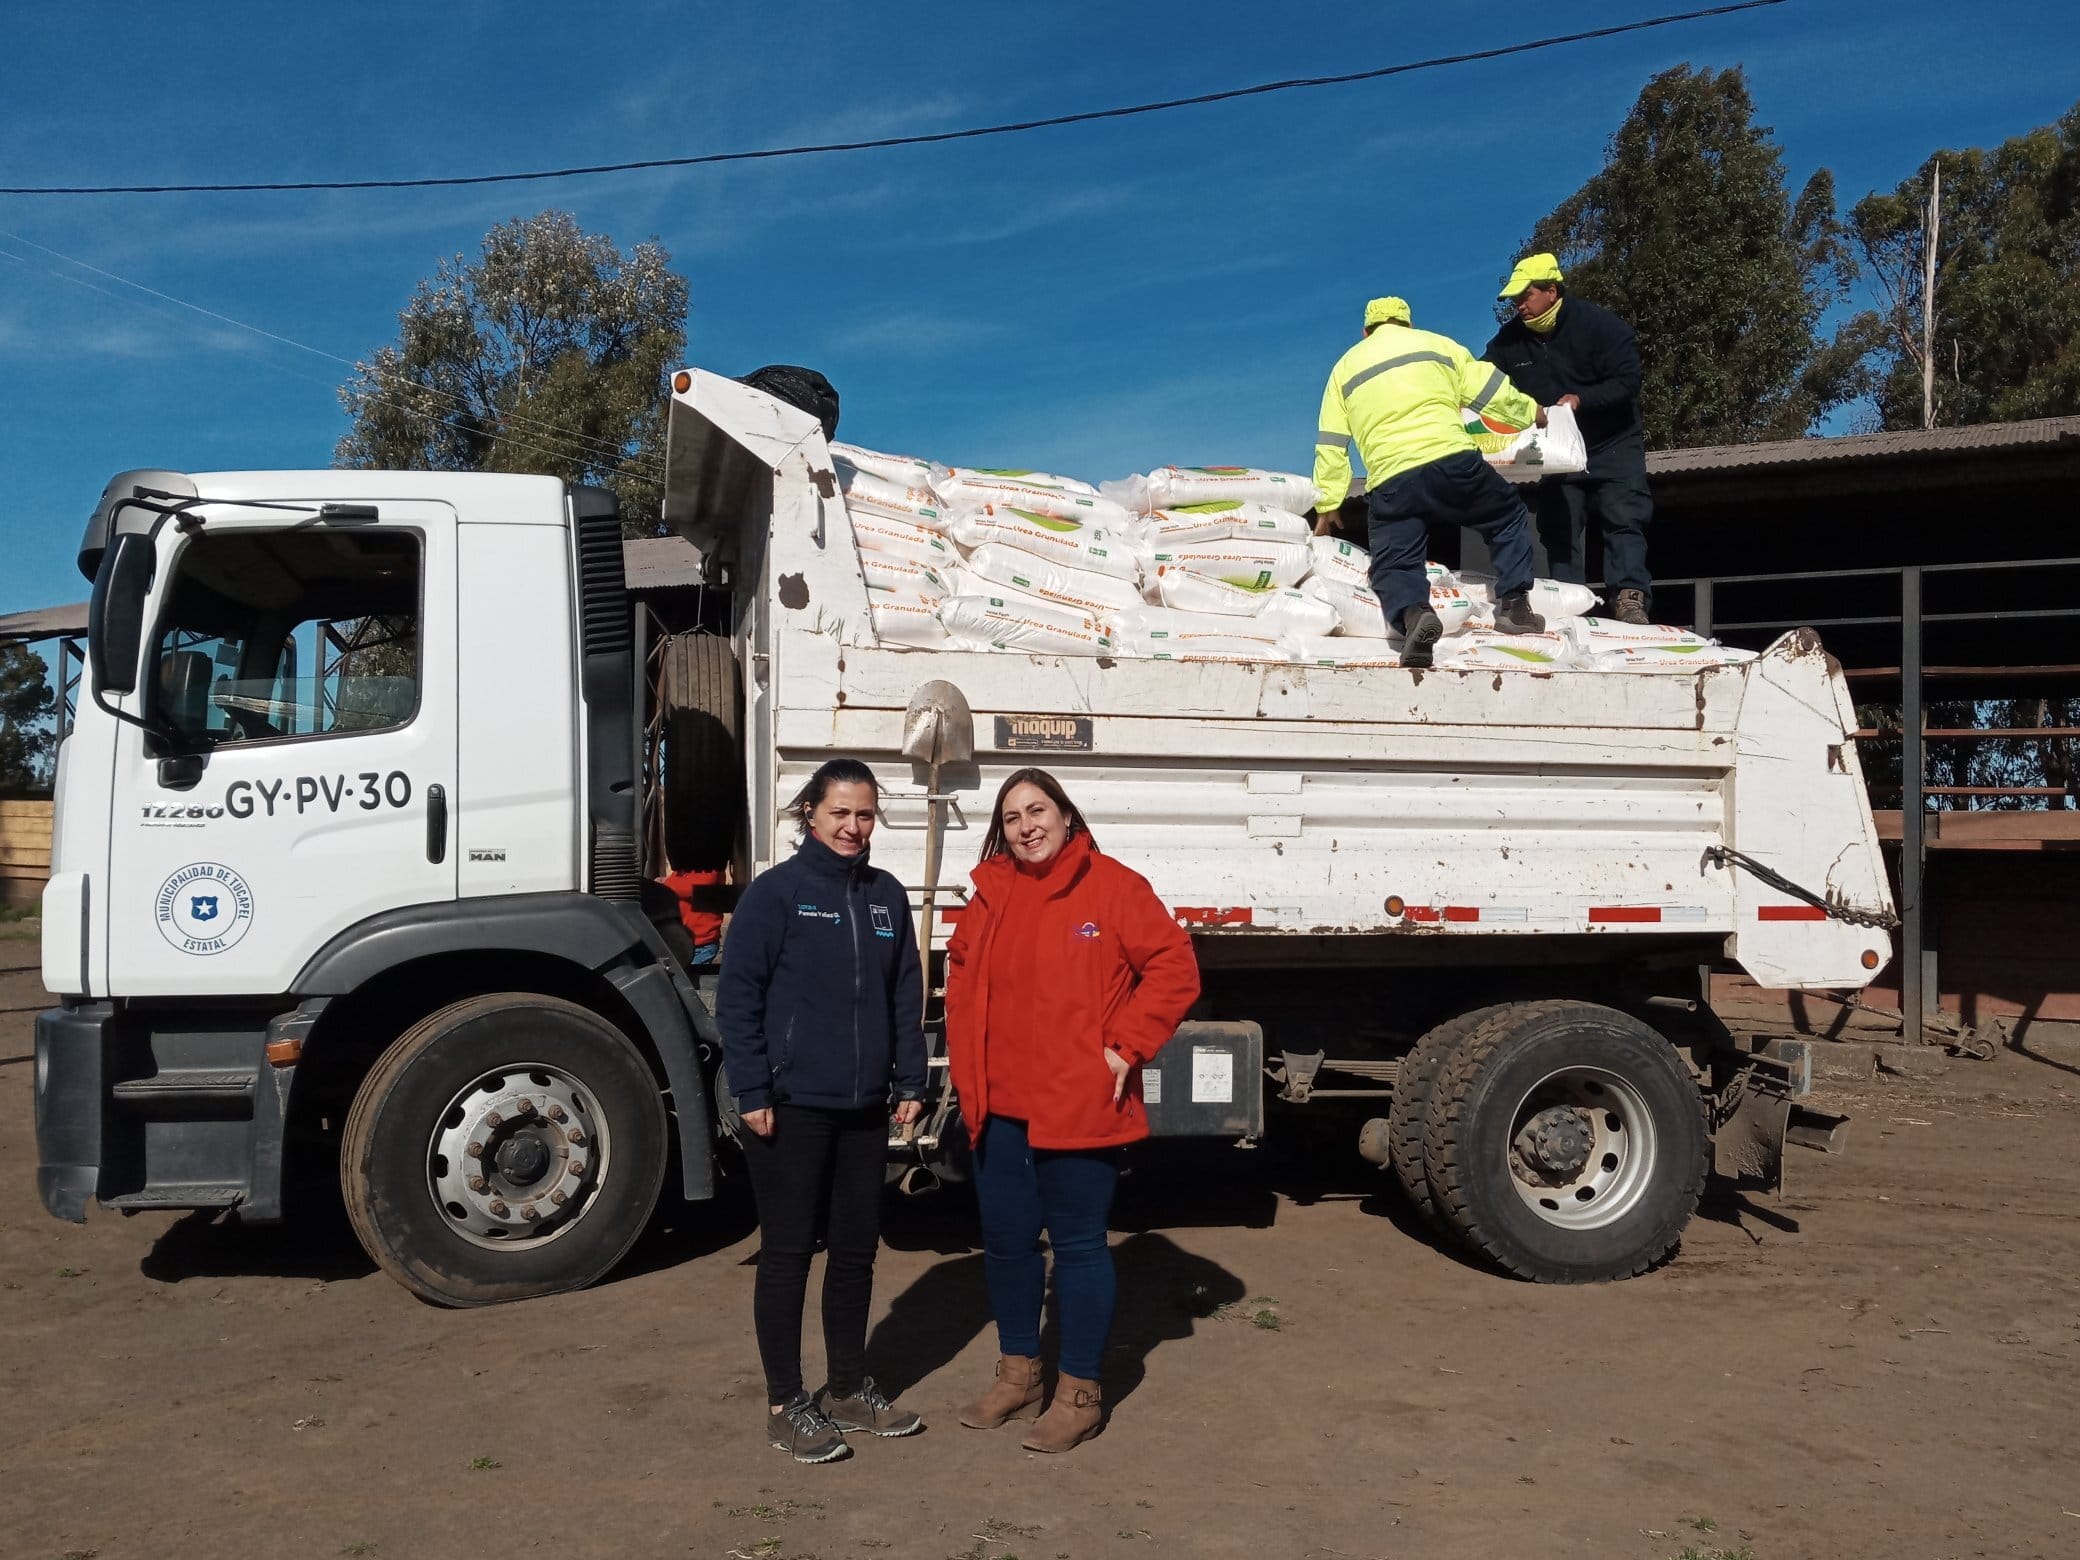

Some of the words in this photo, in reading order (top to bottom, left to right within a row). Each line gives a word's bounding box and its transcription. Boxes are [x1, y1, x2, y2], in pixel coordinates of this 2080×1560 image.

[854, 521, 876, 533] Urea
[877, 527, 925, 545] Granulada
[1012, 525, 1033, 537] Urea
[871, 561, 919, 575] Granulada
[1039, 587, 1083, 605] Granulada
[882, 603, 931, 615] Granulada
[1085, 600, 1105, 612] Urea
[1046, 624, 1092, 641] Granulada
[470, 853, 506, 861] MAN
[159, 866, 214, 922] MUNICIPALIDAD
[216, 868, 231, 882] DE
[229, 877, 250, 920] TUCAPEL
[183, 938, 227, 952] ESTATAL
